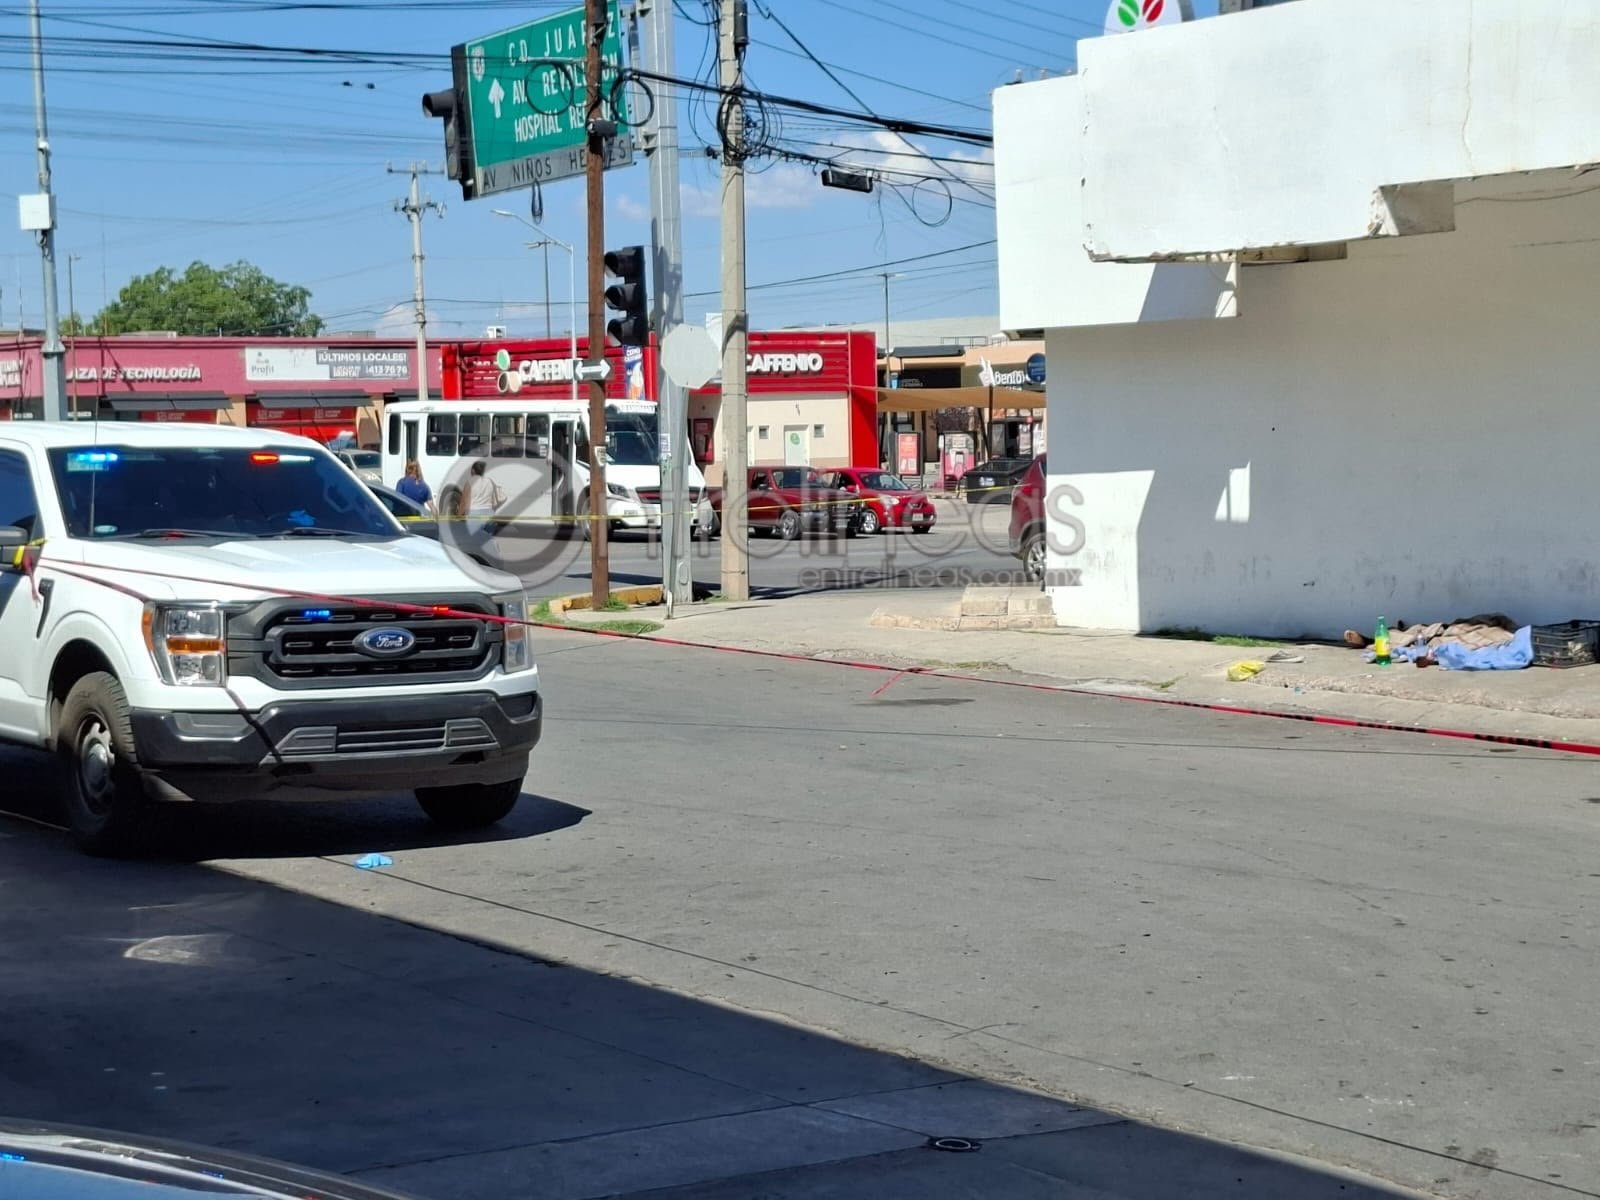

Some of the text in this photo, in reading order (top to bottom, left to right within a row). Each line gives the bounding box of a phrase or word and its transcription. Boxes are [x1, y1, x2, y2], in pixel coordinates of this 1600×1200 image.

[543, 12, 615, 57] JUARZ
[541, 52, 618, 97] REVOLON
[515, 109, 562, 143] HOSPITAL
[483, 139, 627, 191] AV NIÑOS HEES
[119, 364, 202, 380] TECNOLOGÍA
[519, 359, 582, 382] CAFFENI
[376, 634, 404, 648] Ford
